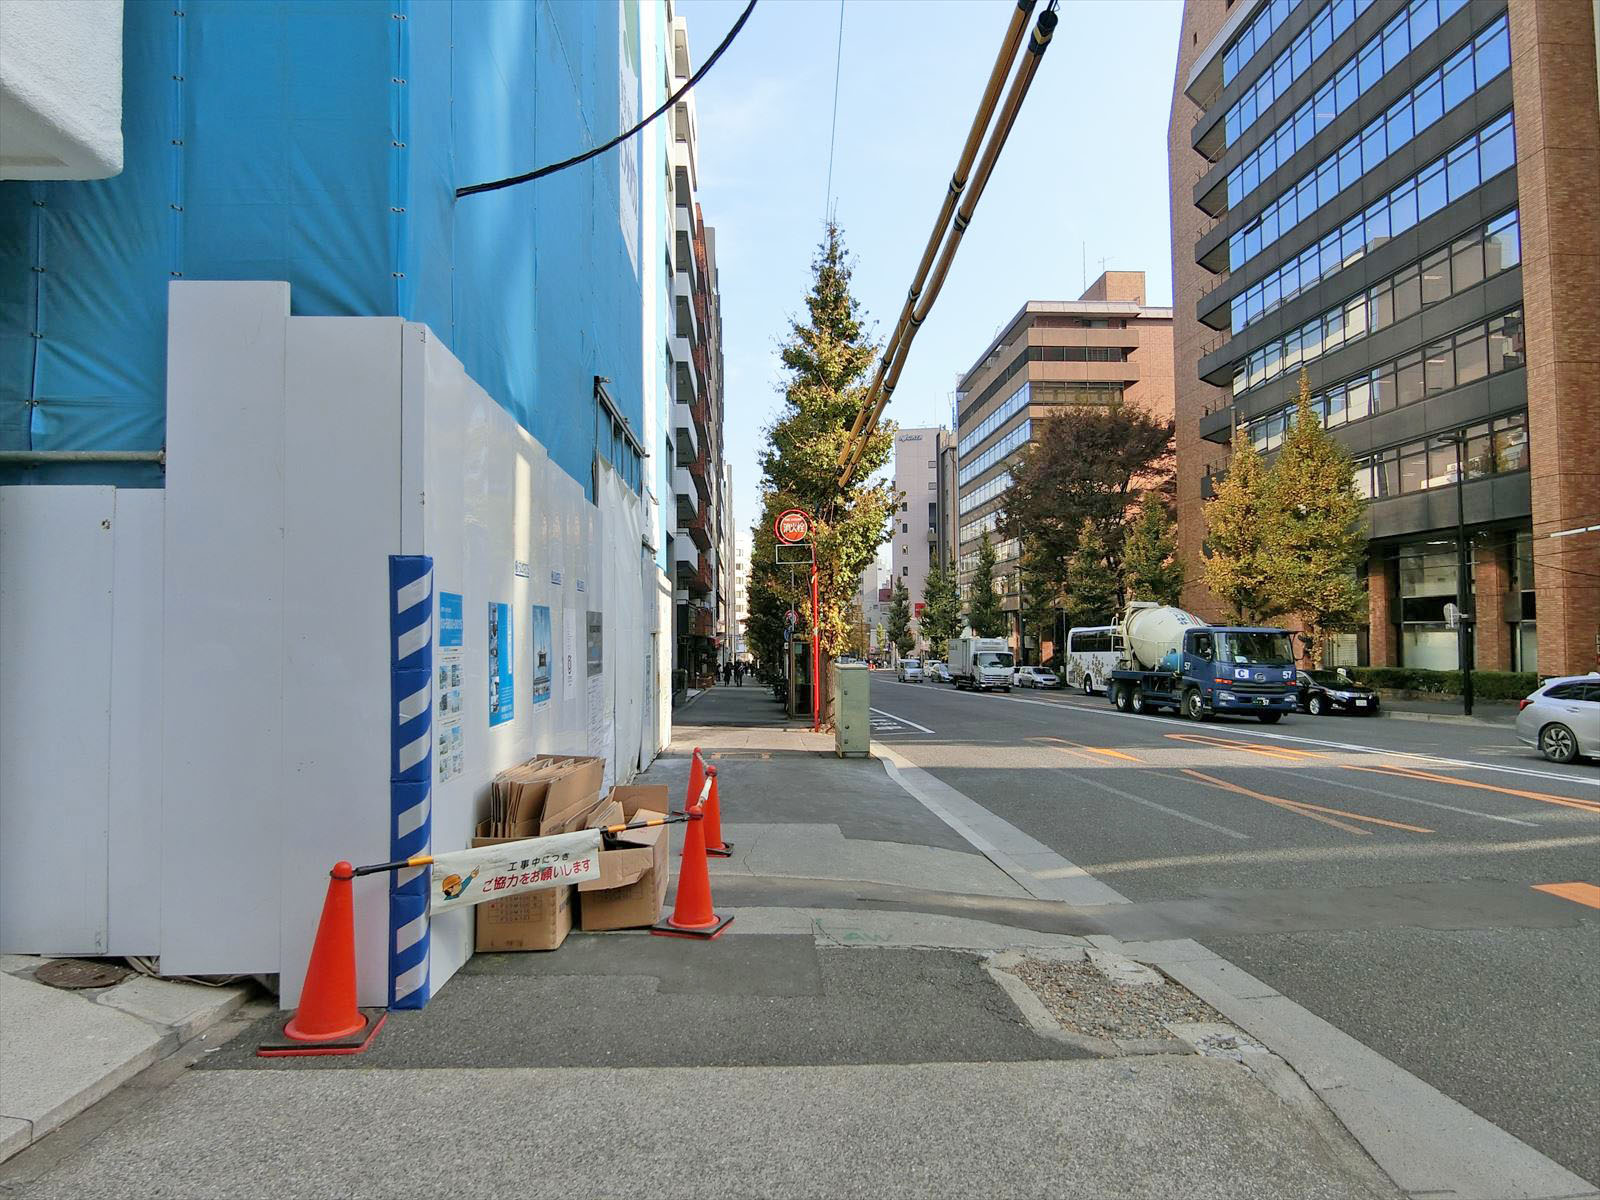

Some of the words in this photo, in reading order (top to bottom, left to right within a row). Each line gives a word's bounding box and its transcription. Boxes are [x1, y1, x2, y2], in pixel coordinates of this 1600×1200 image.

[1184, 662, 1190, 670] 57
[507, 853, 570, 872] 工事中につき
[482, 859, 591, 892] ご協力をお願いします
